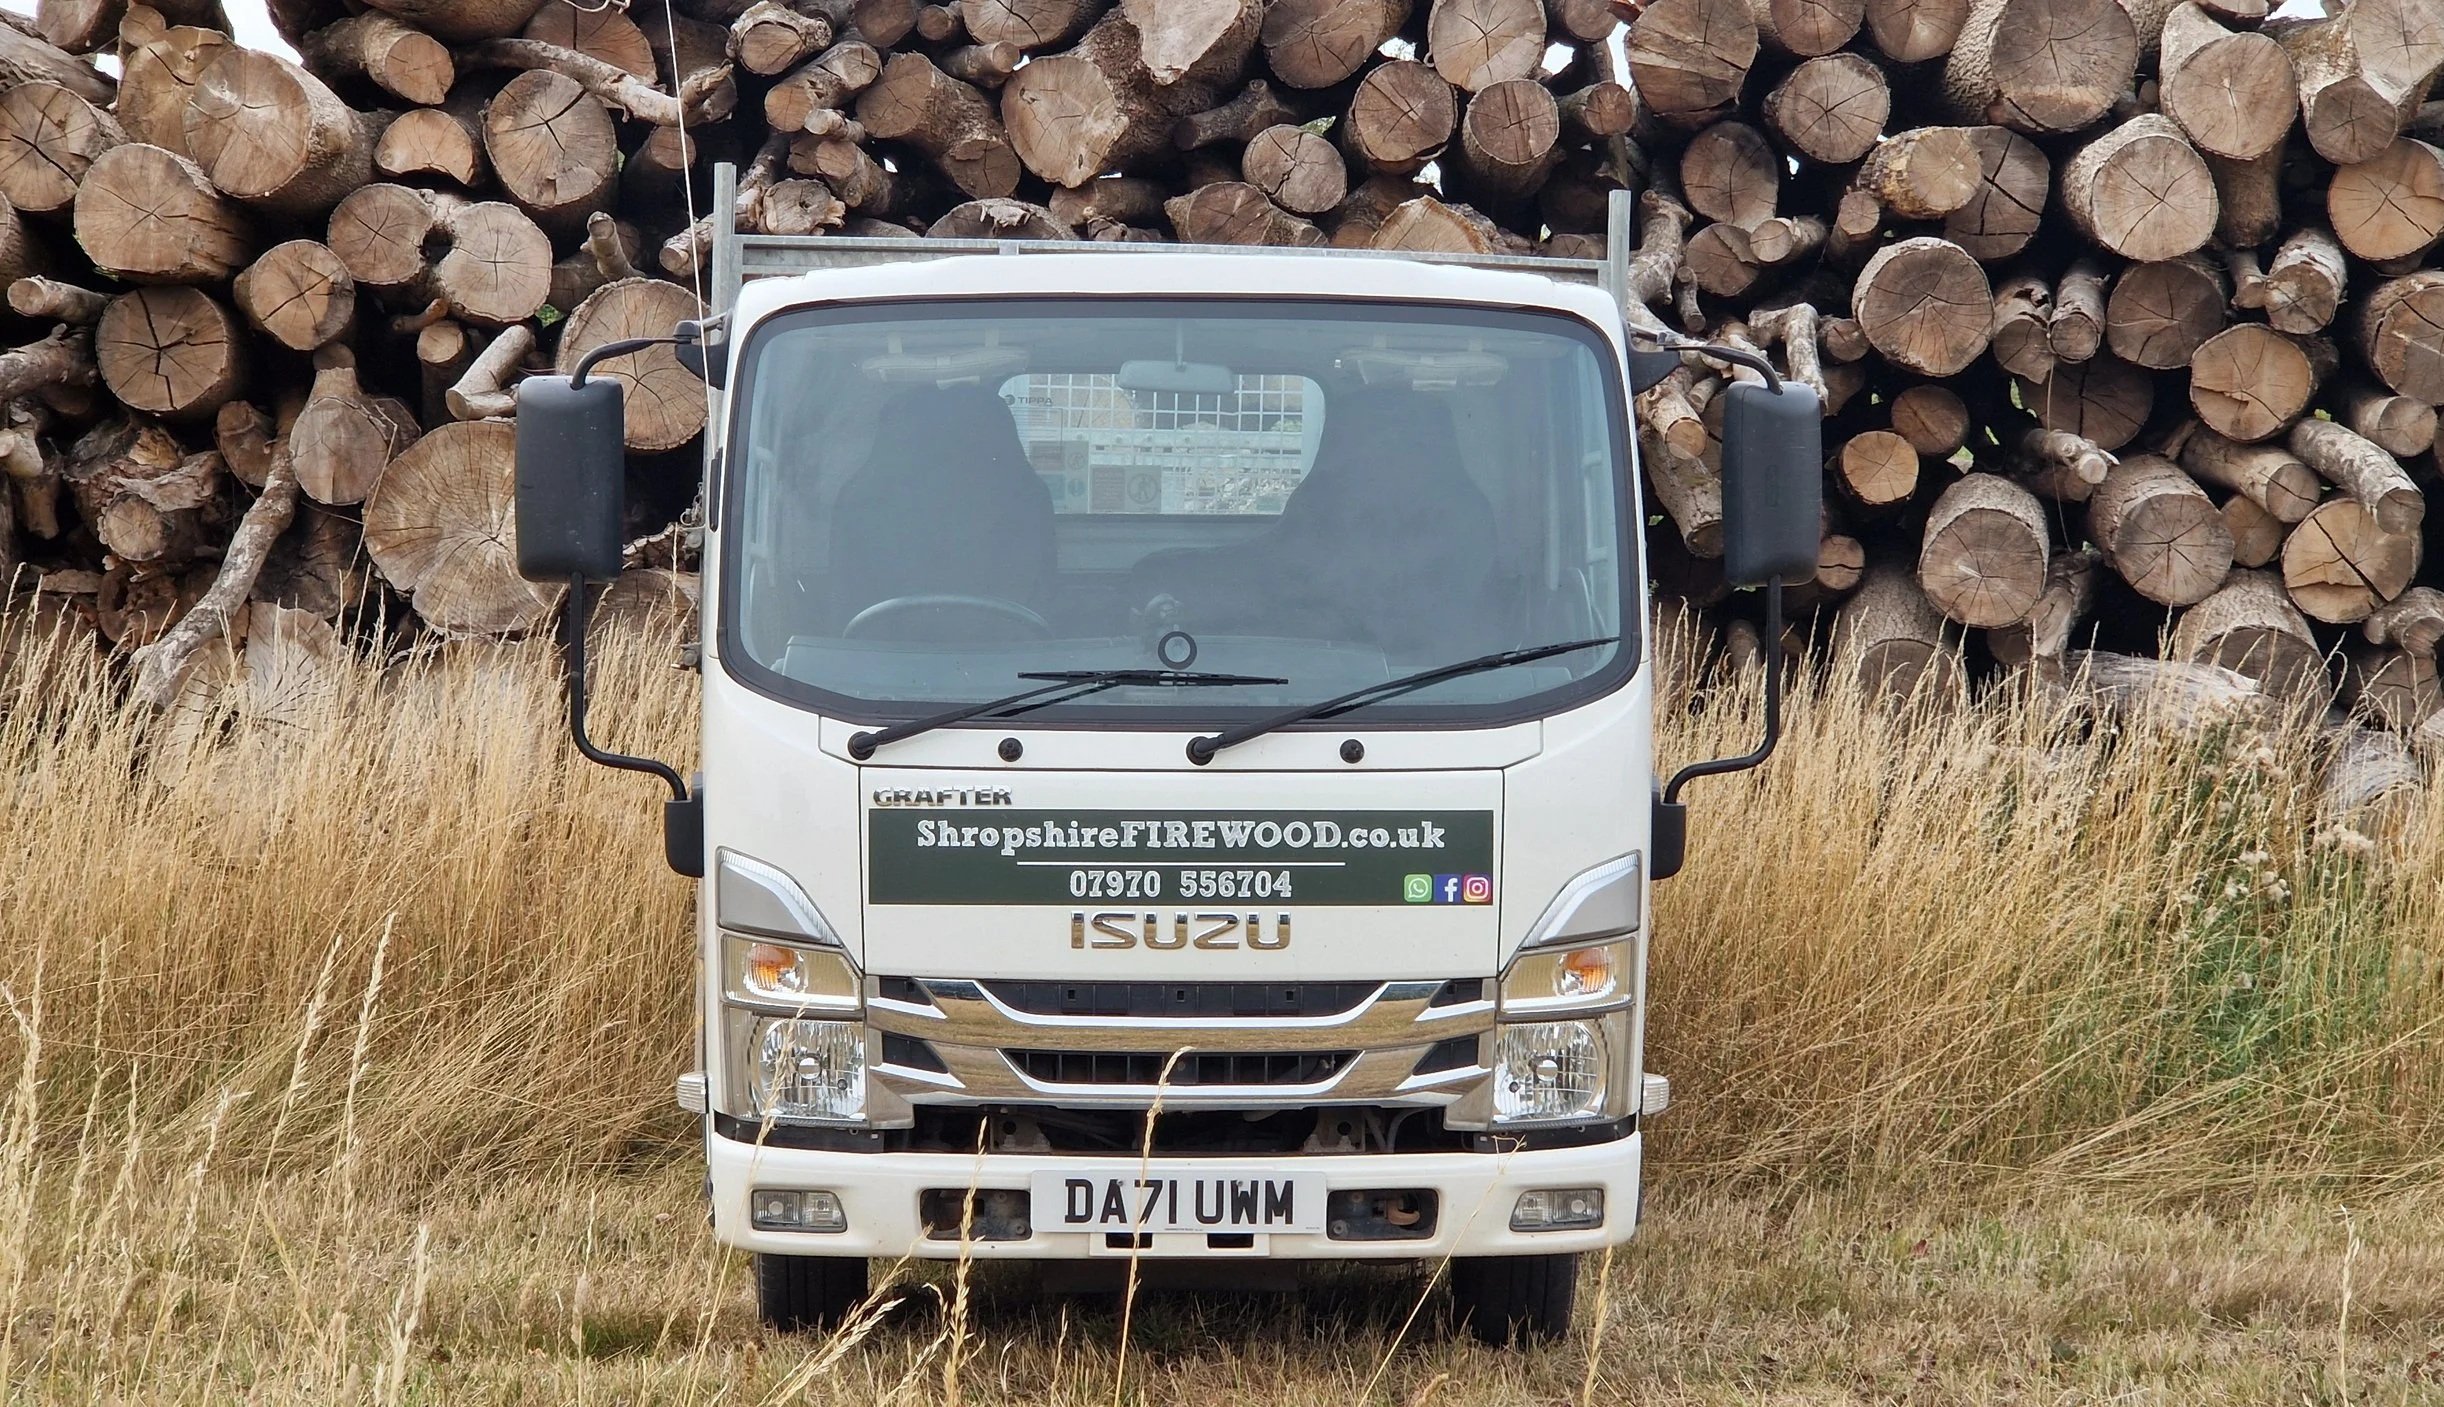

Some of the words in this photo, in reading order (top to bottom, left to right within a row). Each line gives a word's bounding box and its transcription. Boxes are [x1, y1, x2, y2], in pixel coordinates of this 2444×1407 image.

[873, 785, 1012, 806] GRAFTER
[917, 820, 1446, 856] ShropshireFIREWOOD.co.uk
[1069, 870, 1161, 898] 07970
[1179, 870, 1292, 898] 556704
[1071, 911, 1291, 949] ISUZU
[1064, 1178, 1178, 1225] DA71
[1195, 1179, 1294, 1225] UWM
